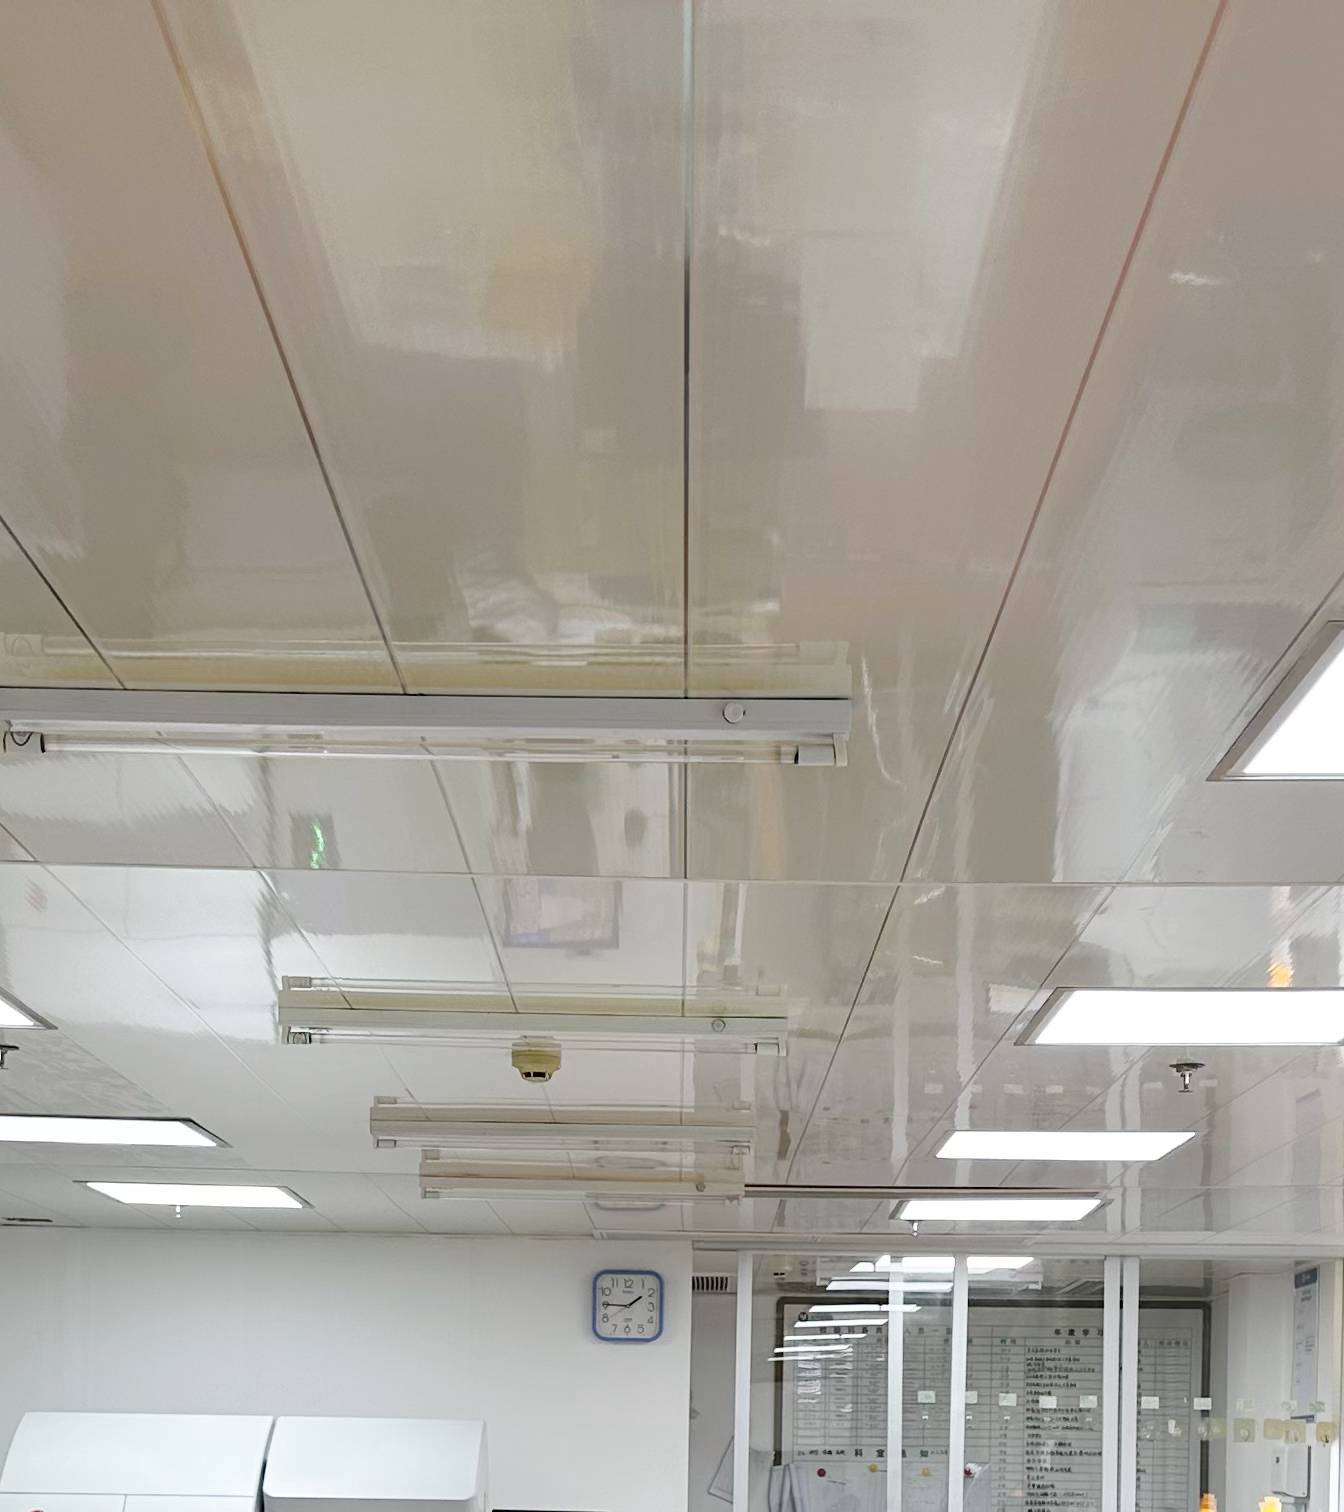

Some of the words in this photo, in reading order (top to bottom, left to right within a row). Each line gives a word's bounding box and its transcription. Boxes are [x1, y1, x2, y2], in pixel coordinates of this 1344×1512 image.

[624, 1279, 634, 1288] 12
[601, 1287, 612, 1296] 10
[647, 1288, 656, 1298] 2
[602, 1313, 609, 1323] 8
[612, 1324, 618, 1334] 7
[638, 1324, 644, 1334] 5
